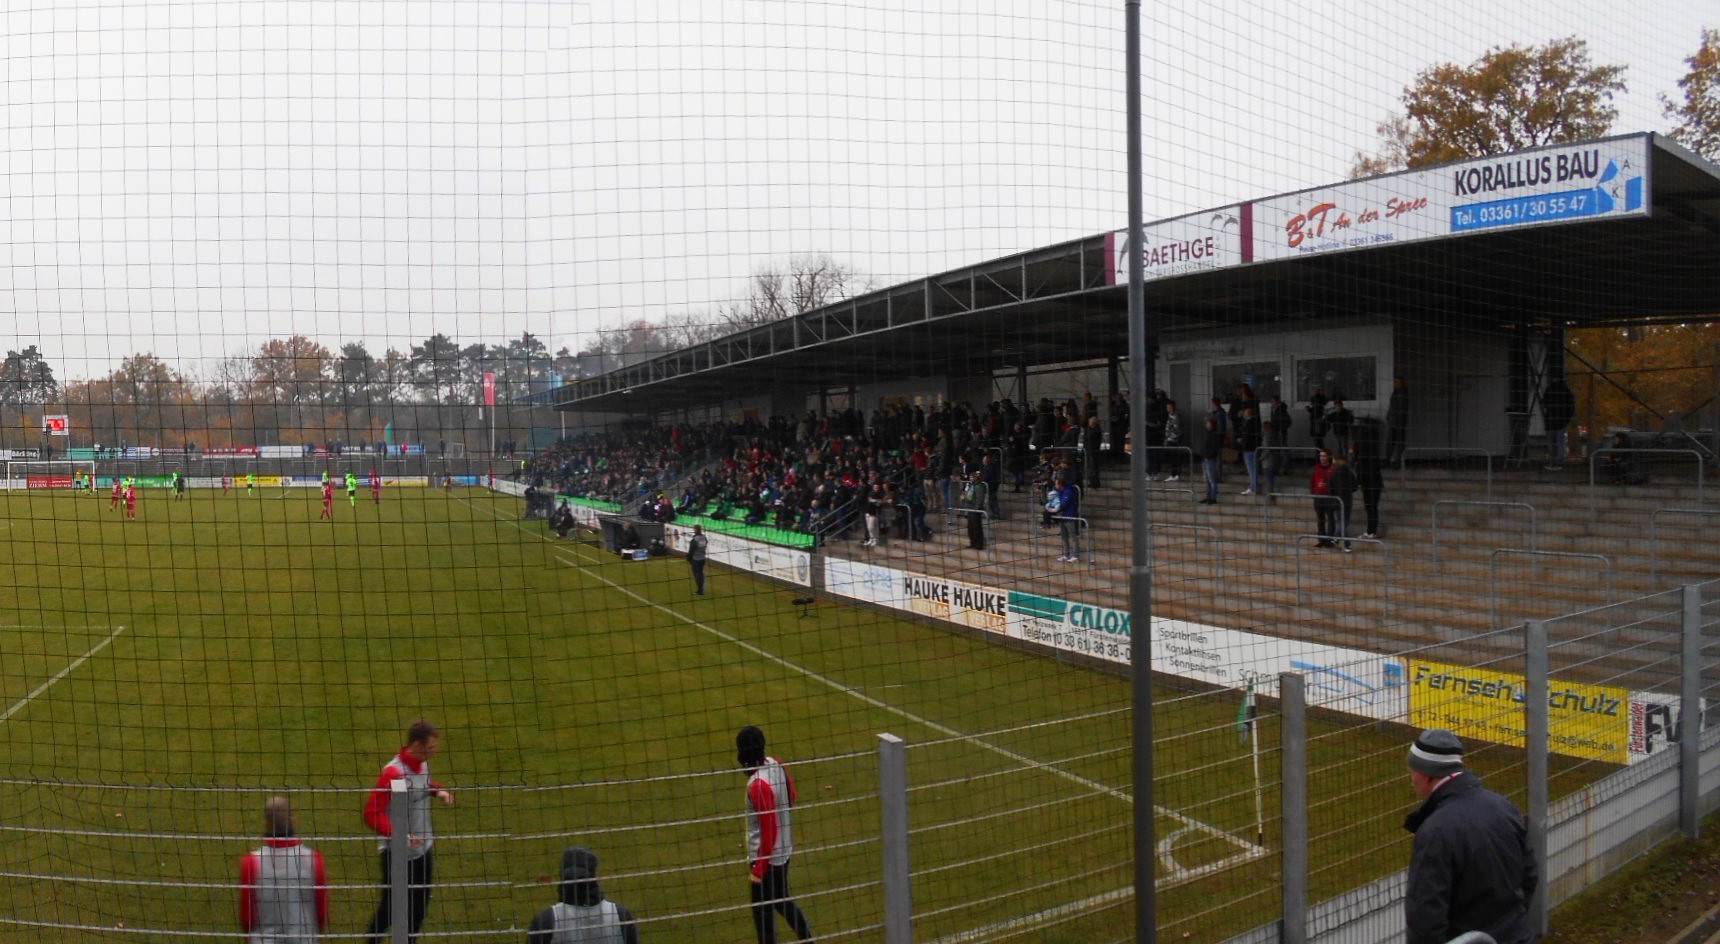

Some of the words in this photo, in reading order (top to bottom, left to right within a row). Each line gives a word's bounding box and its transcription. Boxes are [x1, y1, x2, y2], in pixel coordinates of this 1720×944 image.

[1455, 156, 1552, 196] KORALLUS
[1557, 150, 1599, 182] BAU
[1622, 159, 1631, 169] A
[1612, 187, 1620, 198] K
[1331, 212, 1351, 232] An
[1358, 207, 1380, 224] der
[1385, 196, 1428, 219] Spree
[1455, 211, 1476, 226] Tel.
[1550, 198, 1566, 214] 55
[1569, 195, 1588, 212] 47
[1142, 236, 1214, 269] BAETHGE
[904, 576, 950, 604] HAUKE
[954, 586, 1007, 616] HAUKE
[1022, 624, 1052, 642] Telefon
[1069, 604, 1133, 637] CALOX
[1159, 627, 1208, 644] Sportbrillen
[1165, 642, 1222, 661] Kontaktlinsen
[1169, 656, 1227, 677] Sonnenbrillen
[1414, 665, 1514, 701] Fernseh
[1547, 686, 1621, 716] chulz
